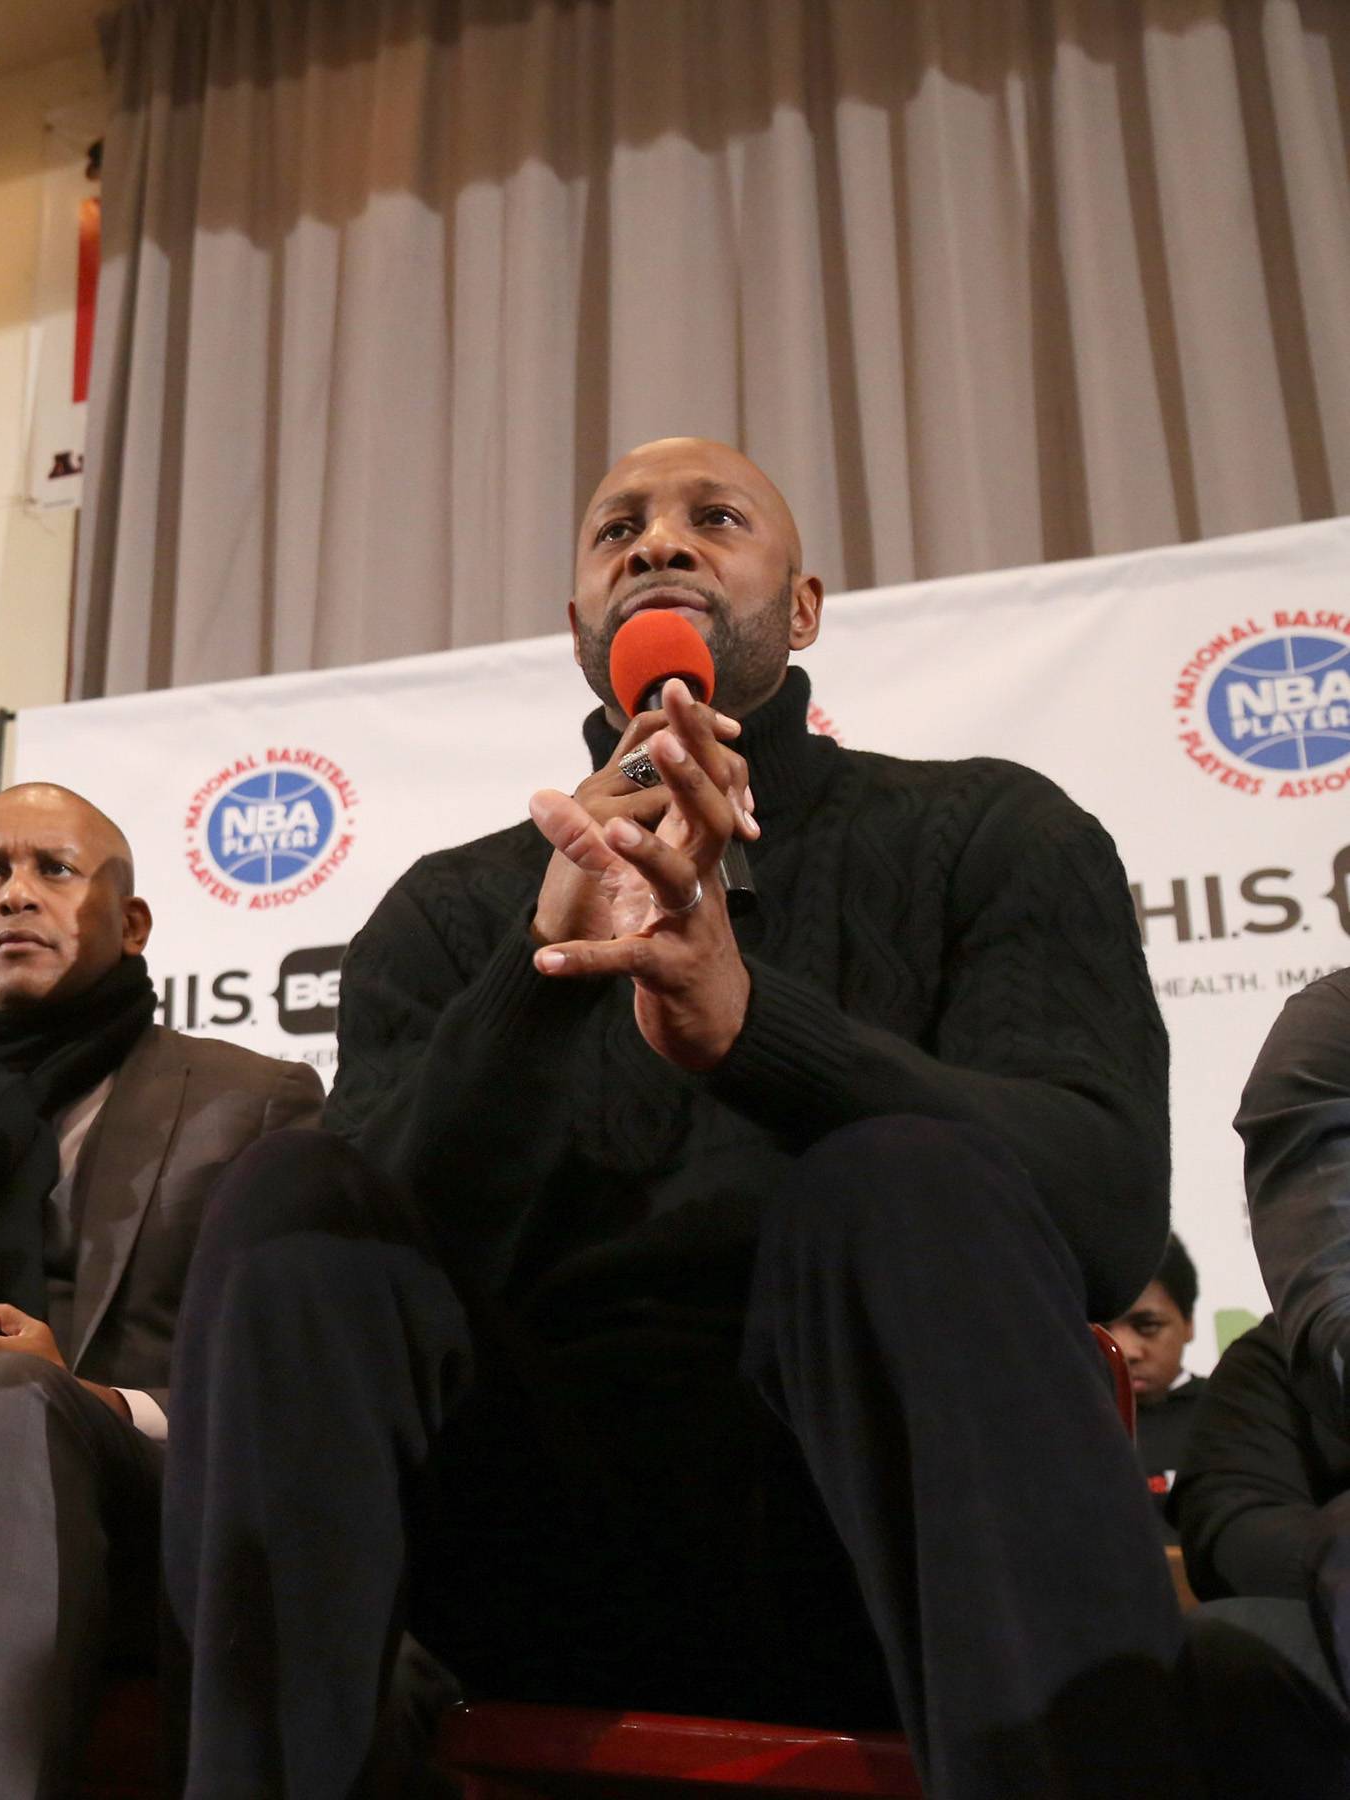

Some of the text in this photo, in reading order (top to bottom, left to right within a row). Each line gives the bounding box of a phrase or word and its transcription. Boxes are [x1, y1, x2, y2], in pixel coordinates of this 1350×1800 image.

[1173, 617, 1264, 709] NATIONAL
[1226, 669, 1350, 720] NBA
[185, 747, 360, 829] NATIONAL BASKETBALL
[1179, 730, 1264, 796] PLAYERS
[221, 800, 320, 839] NBA
[222, 829, 319, 857] PLAYERS
[186, 833, 354, 910] PLAYERS ASSOCIATION
[1128, 867, 1311, 944] H.I.S.
